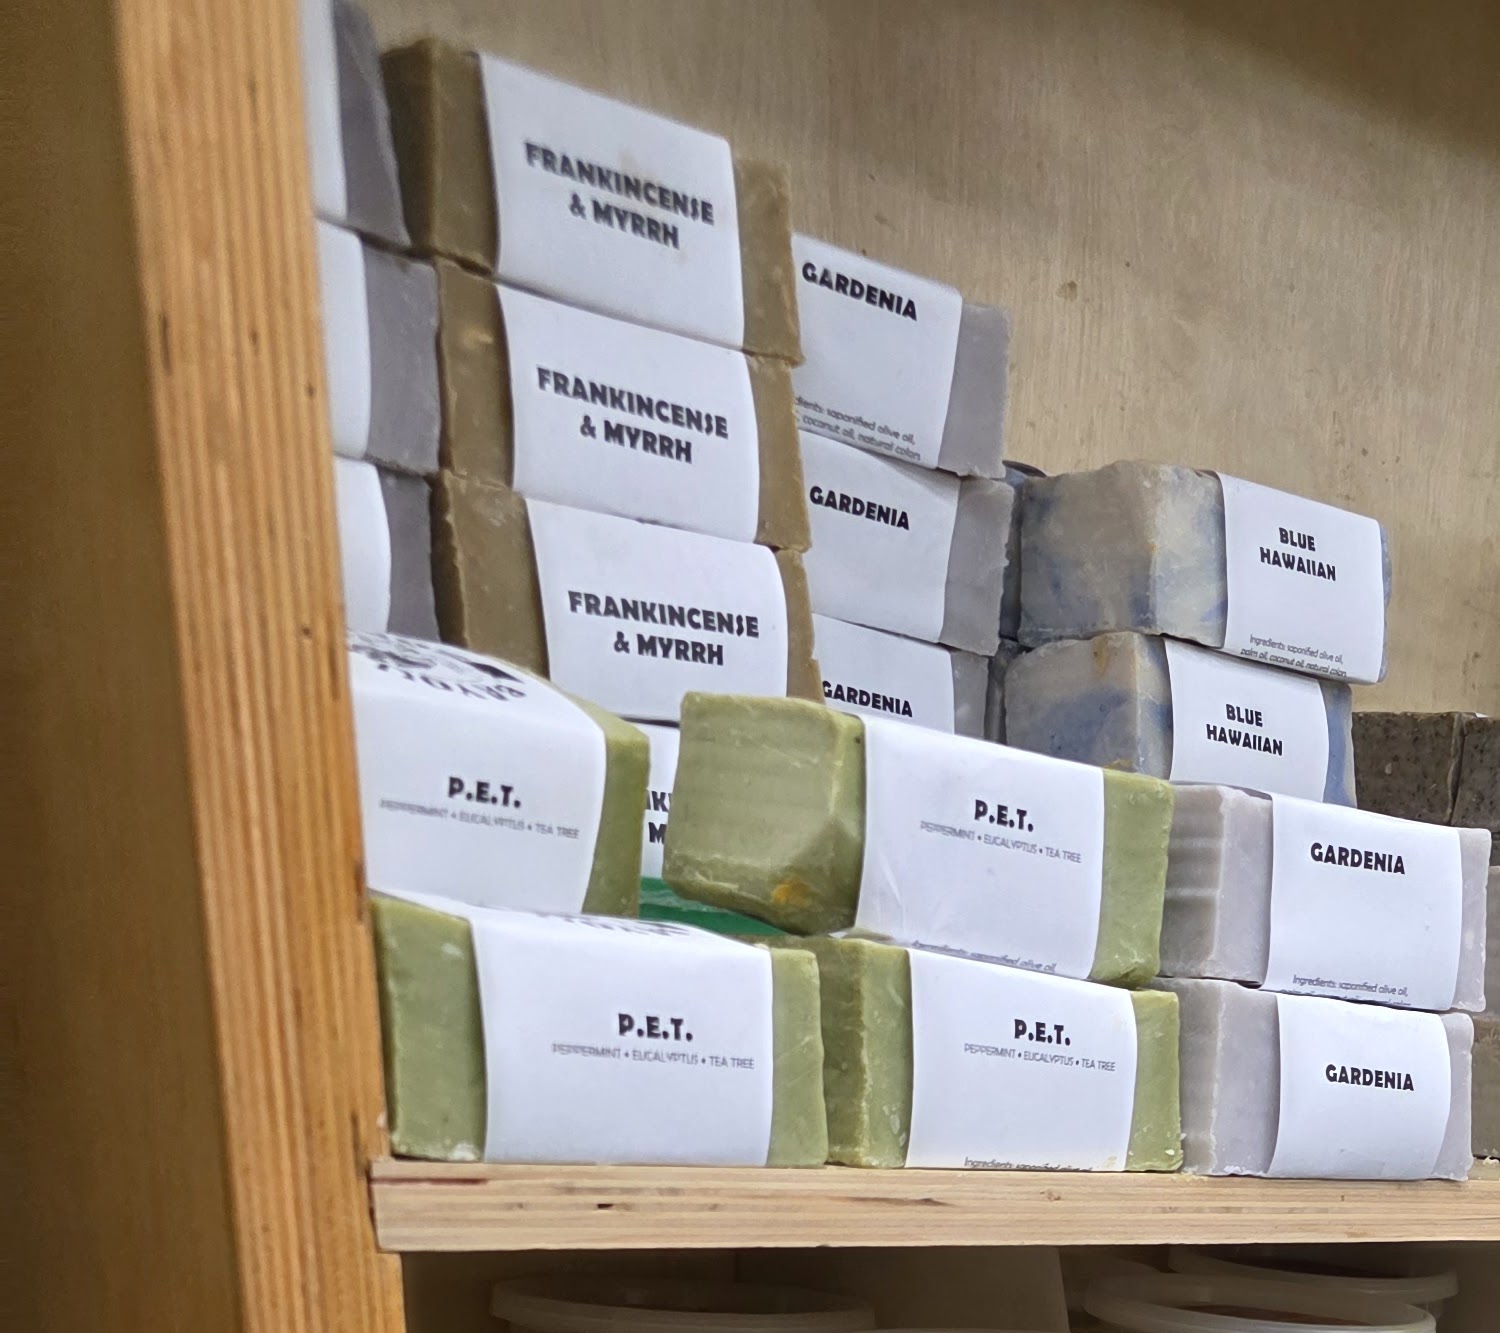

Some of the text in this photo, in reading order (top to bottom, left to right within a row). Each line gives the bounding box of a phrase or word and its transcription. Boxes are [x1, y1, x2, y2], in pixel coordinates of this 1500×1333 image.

[524, 142, 715, 226] FRANKINCENSE
[570, 192, 680, 249] & MYRRH
[802, 262, 917, 321] GARDENIA
[536, 366, 729, 439] FRANKINCENSE
[580, 414, 693, 465] & MYRRH
[809, 485, 910, 532] GARDENIA
[1278, 527, 1316, 552] BLUE
[1259, 547, 1336, 581] HAWAIIAN
[568, 591, 760, 638] FRANKINCENSE
[613, 633, 724, 666] & MYRRH
[822, 679, 913, 718] GARDENIA
[1226, 703, 1263, 728] BLUE
[1206, 723, 1283, 756] HAWAIIAN
[447, 776, 522, 809] P.E.T.
[974, 799, 1034, 832] P.E.T.
[1045, 846, 1061, 858] TEA
[1062, 849, 1082, 863] TREE
[1310, 842, 1406, 875] GARDENIA
[617, 1014, 694, 1042] P.E.T.
[1014, 1019, 1072, 1046] P.E.T.
[631, 1050, 699, 1066] EUCALYPTUS
[709, 1056, 730, 1068] TEA
[732, 1057, 756, 1071] TREE
[964, 1042, 1116, 1072] PEPPERMINT EUCALYPTUS TEA TREE
[1325, 1063, 1415, 1092] GARDENIA
